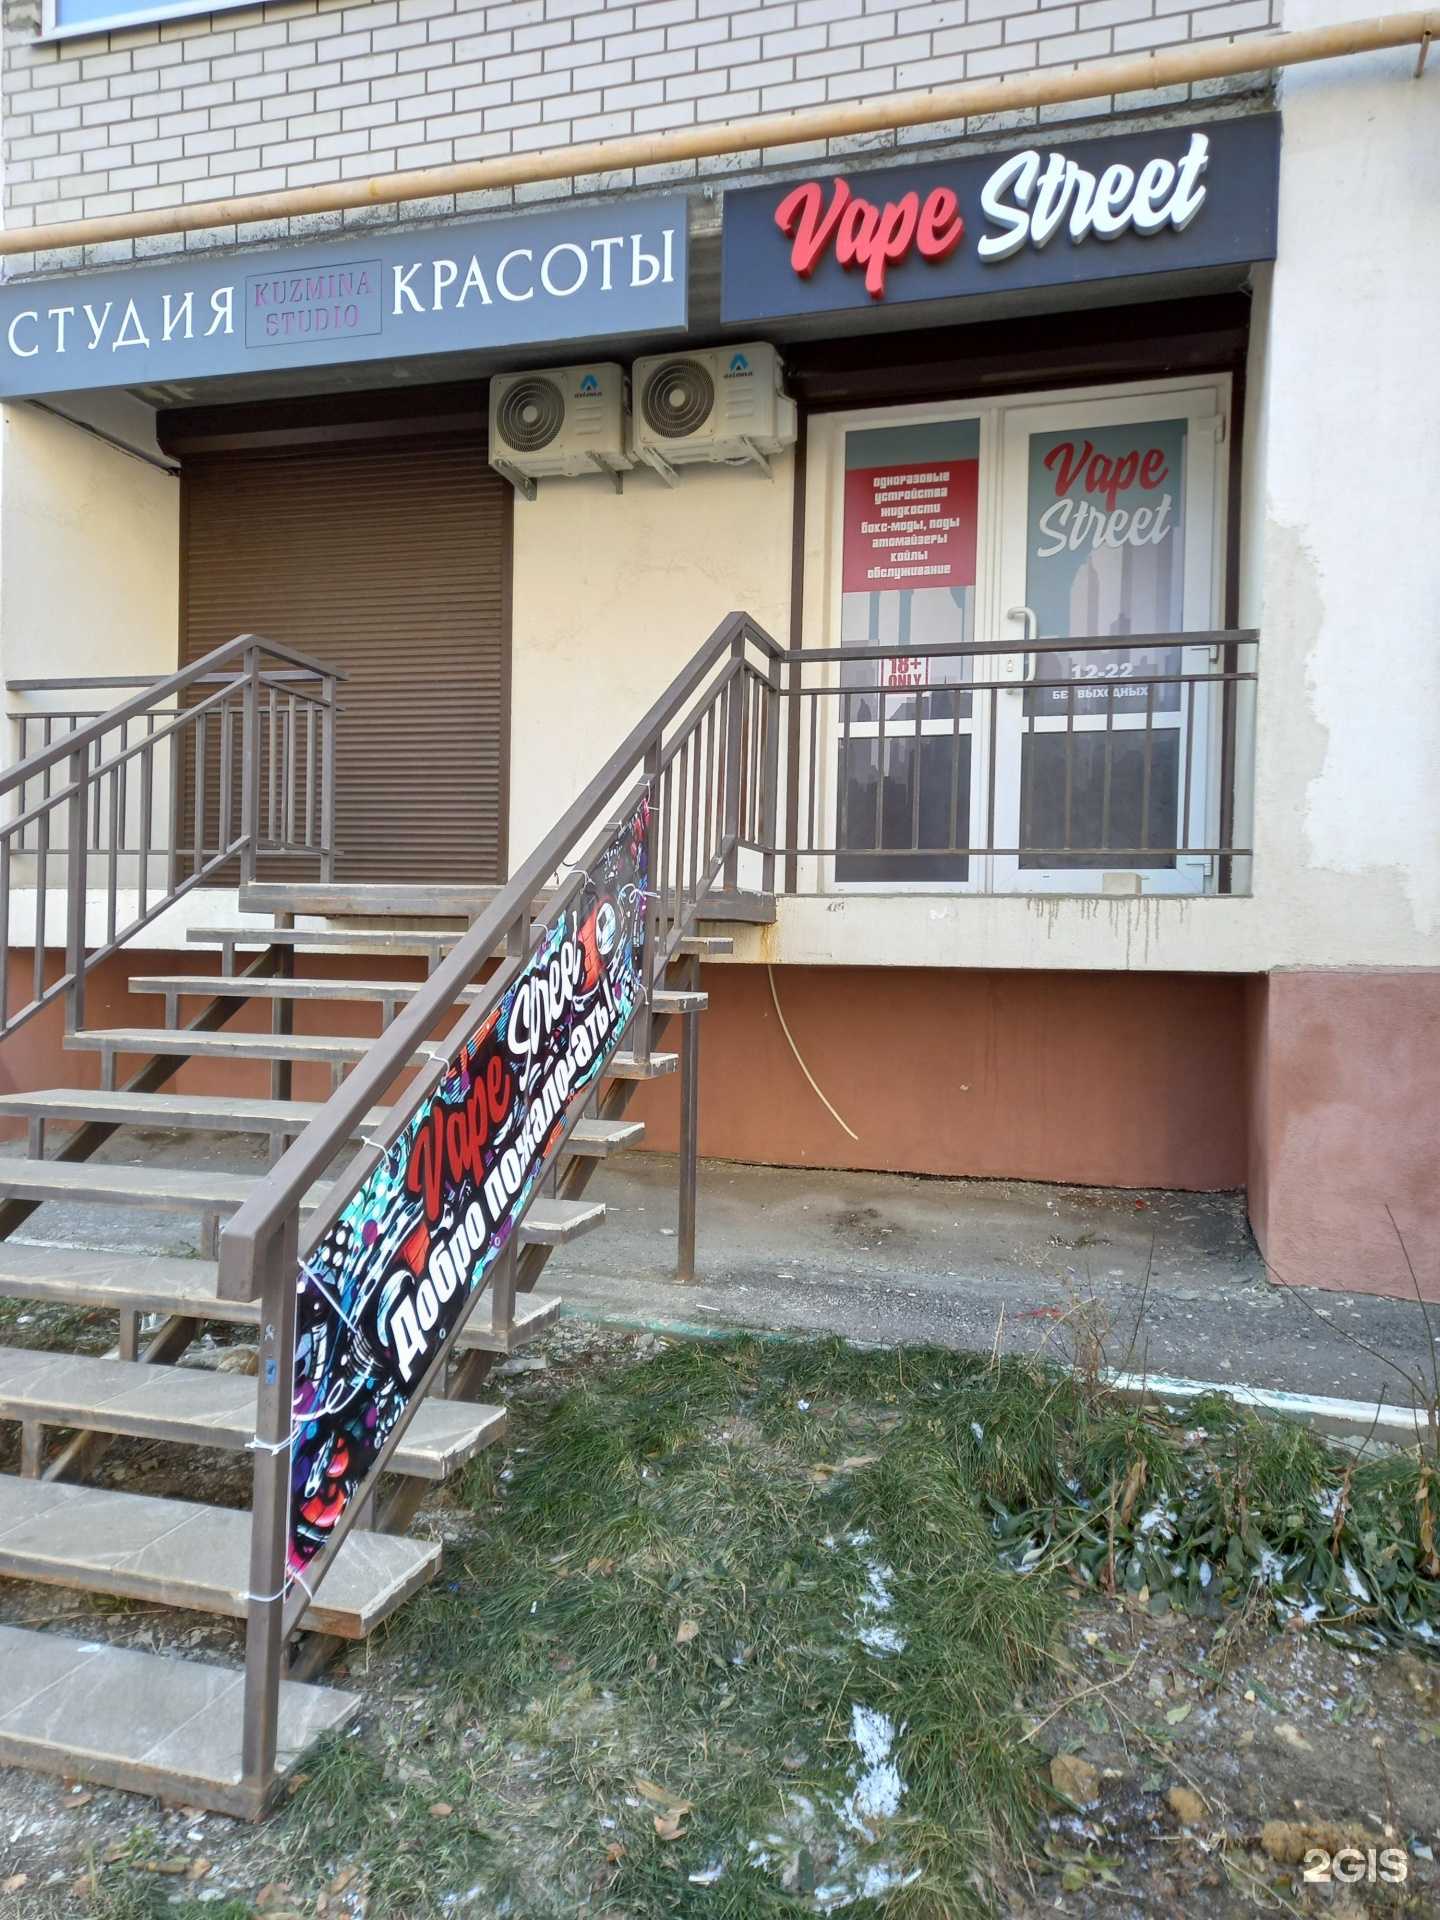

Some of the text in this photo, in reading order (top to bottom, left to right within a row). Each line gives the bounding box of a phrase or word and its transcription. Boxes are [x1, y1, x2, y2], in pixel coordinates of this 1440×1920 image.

[774, 133, 1209, 299] Vape Street
[7, 229, 675, 358] СТУДИЯ КРАСОТЫ
[255, 271, 375, 307] KUZMINA
[266, 304, 360, 336] STUDIO
[873, 472, 950, 489] одноразовые
[1044, 439, 1169, 512] Vape
[875, 487, 948, 505] устройства
[880, 503, 941, 518] жидкости
[861, 517, 960, 534] бокс-моды, поды
[1037, 494, 1172, 557] Street
[872, 533, 948, 548] атомайзеры
[890, 550, 928, 563] койлы
[867, 564, 951, 580] обслуживание
[888, 656, 921, 674] 18+
[1071, 662, 1134, 680] 12-22
[1052, 689, 1071, 700] БЕ
[407, 1055, 511, 1222] Vape
[390, 1201, 487, 1383] Добро
